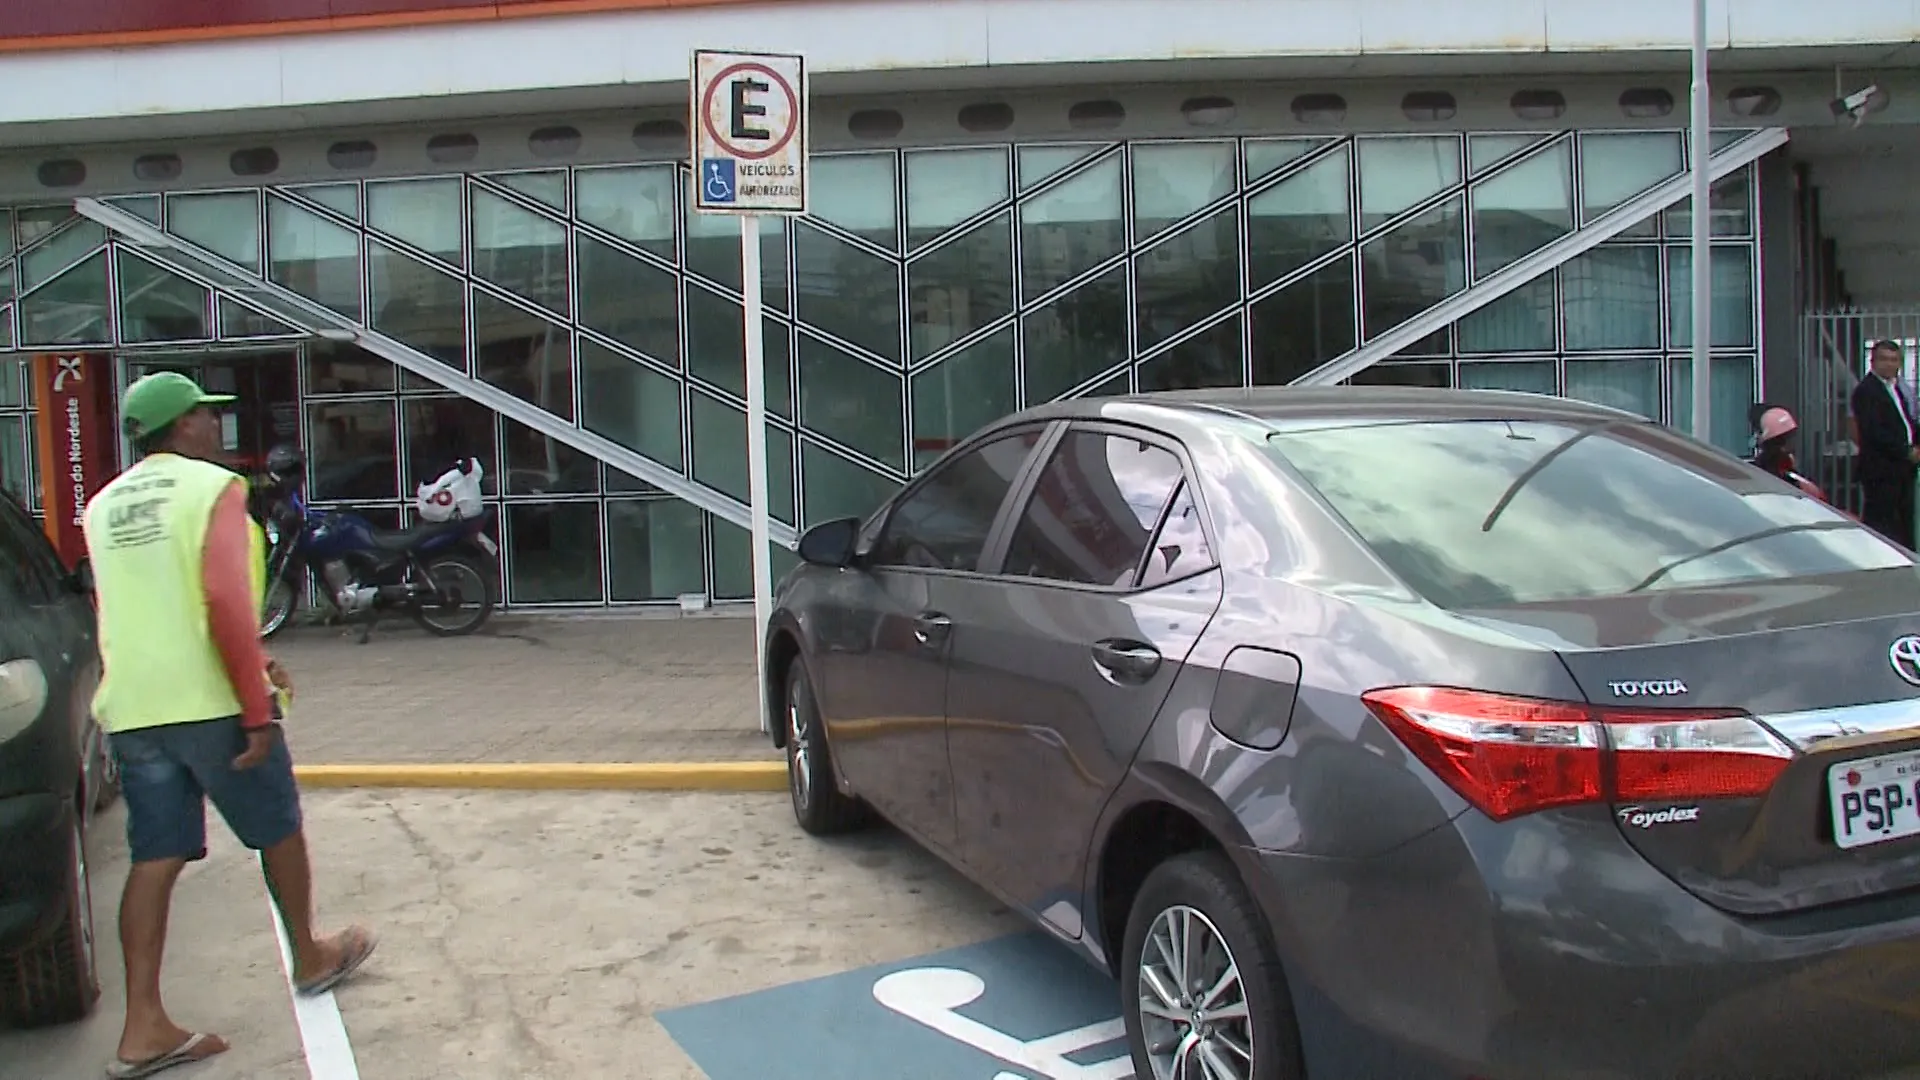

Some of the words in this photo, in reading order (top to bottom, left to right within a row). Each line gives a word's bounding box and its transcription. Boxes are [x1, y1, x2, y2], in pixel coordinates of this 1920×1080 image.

[731, 81, 769, 139] E
[739, 162, 795, 176] VEÍCULOS
[66, 397, 82, 462] Nordeste
[69, 464, 84, 482] do
[73, 484, 86, 526] Banco
[1609, 680, 1688, 697] TOYOTA
[1618, 806, 1700, 829] Toyolex
